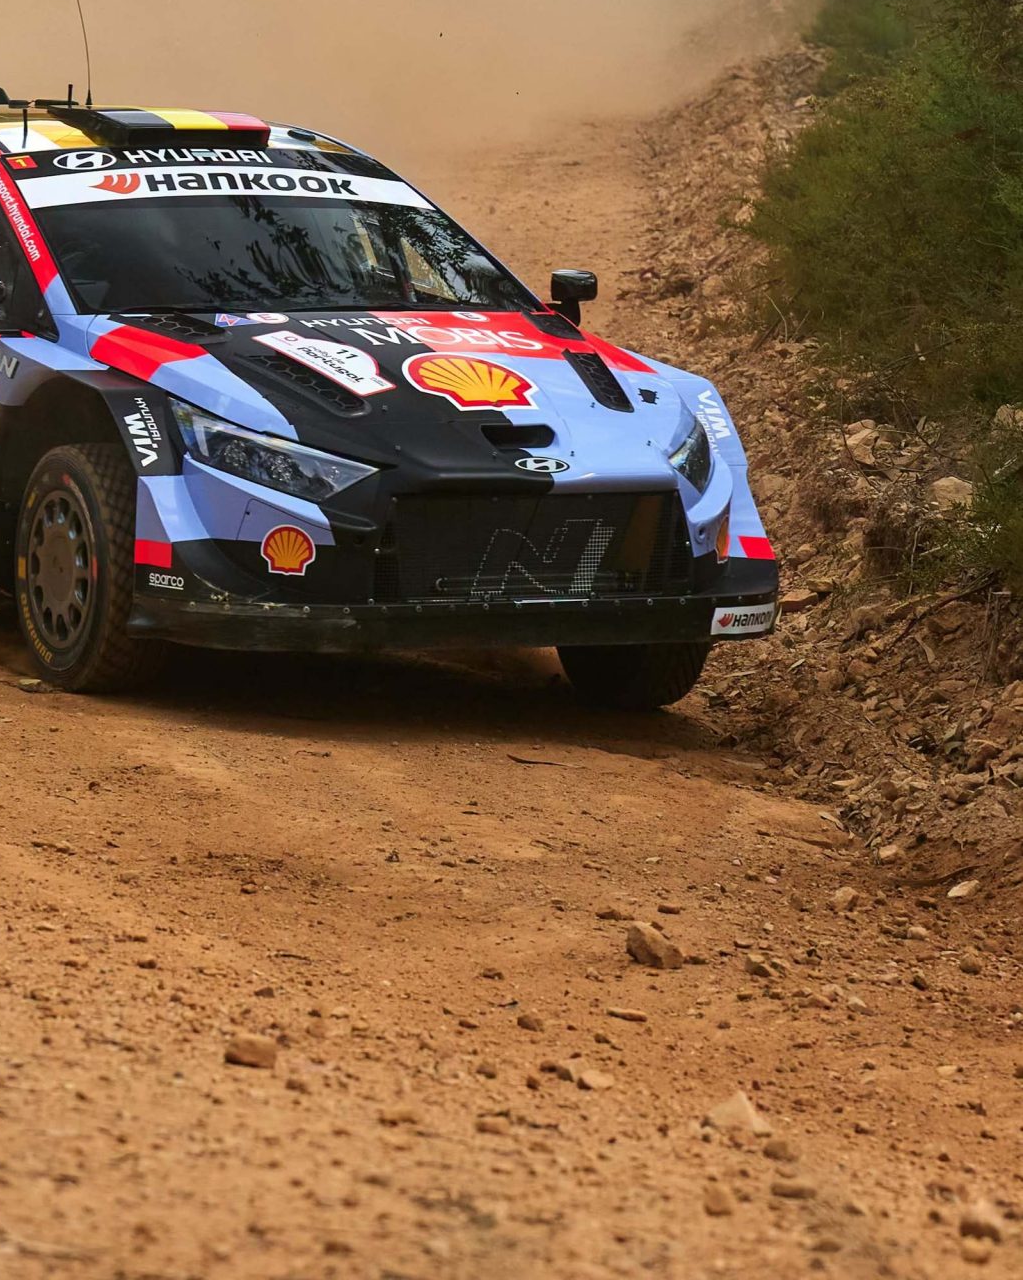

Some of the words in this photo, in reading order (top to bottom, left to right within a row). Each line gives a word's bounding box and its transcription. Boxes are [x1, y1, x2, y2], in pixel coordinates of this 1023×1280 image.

[126, 149, 274, 165] HYUNDAI
[300, 317, 433, 328] HYUNDAI
[349, 325, 544, 351] MOBIS
[335, 348, 358, 360] 11
[297, 346, 365, 384] Portugal
[134, 397, 162, 441] HYUNDAI
[148, 572, 185, 591] sparco
